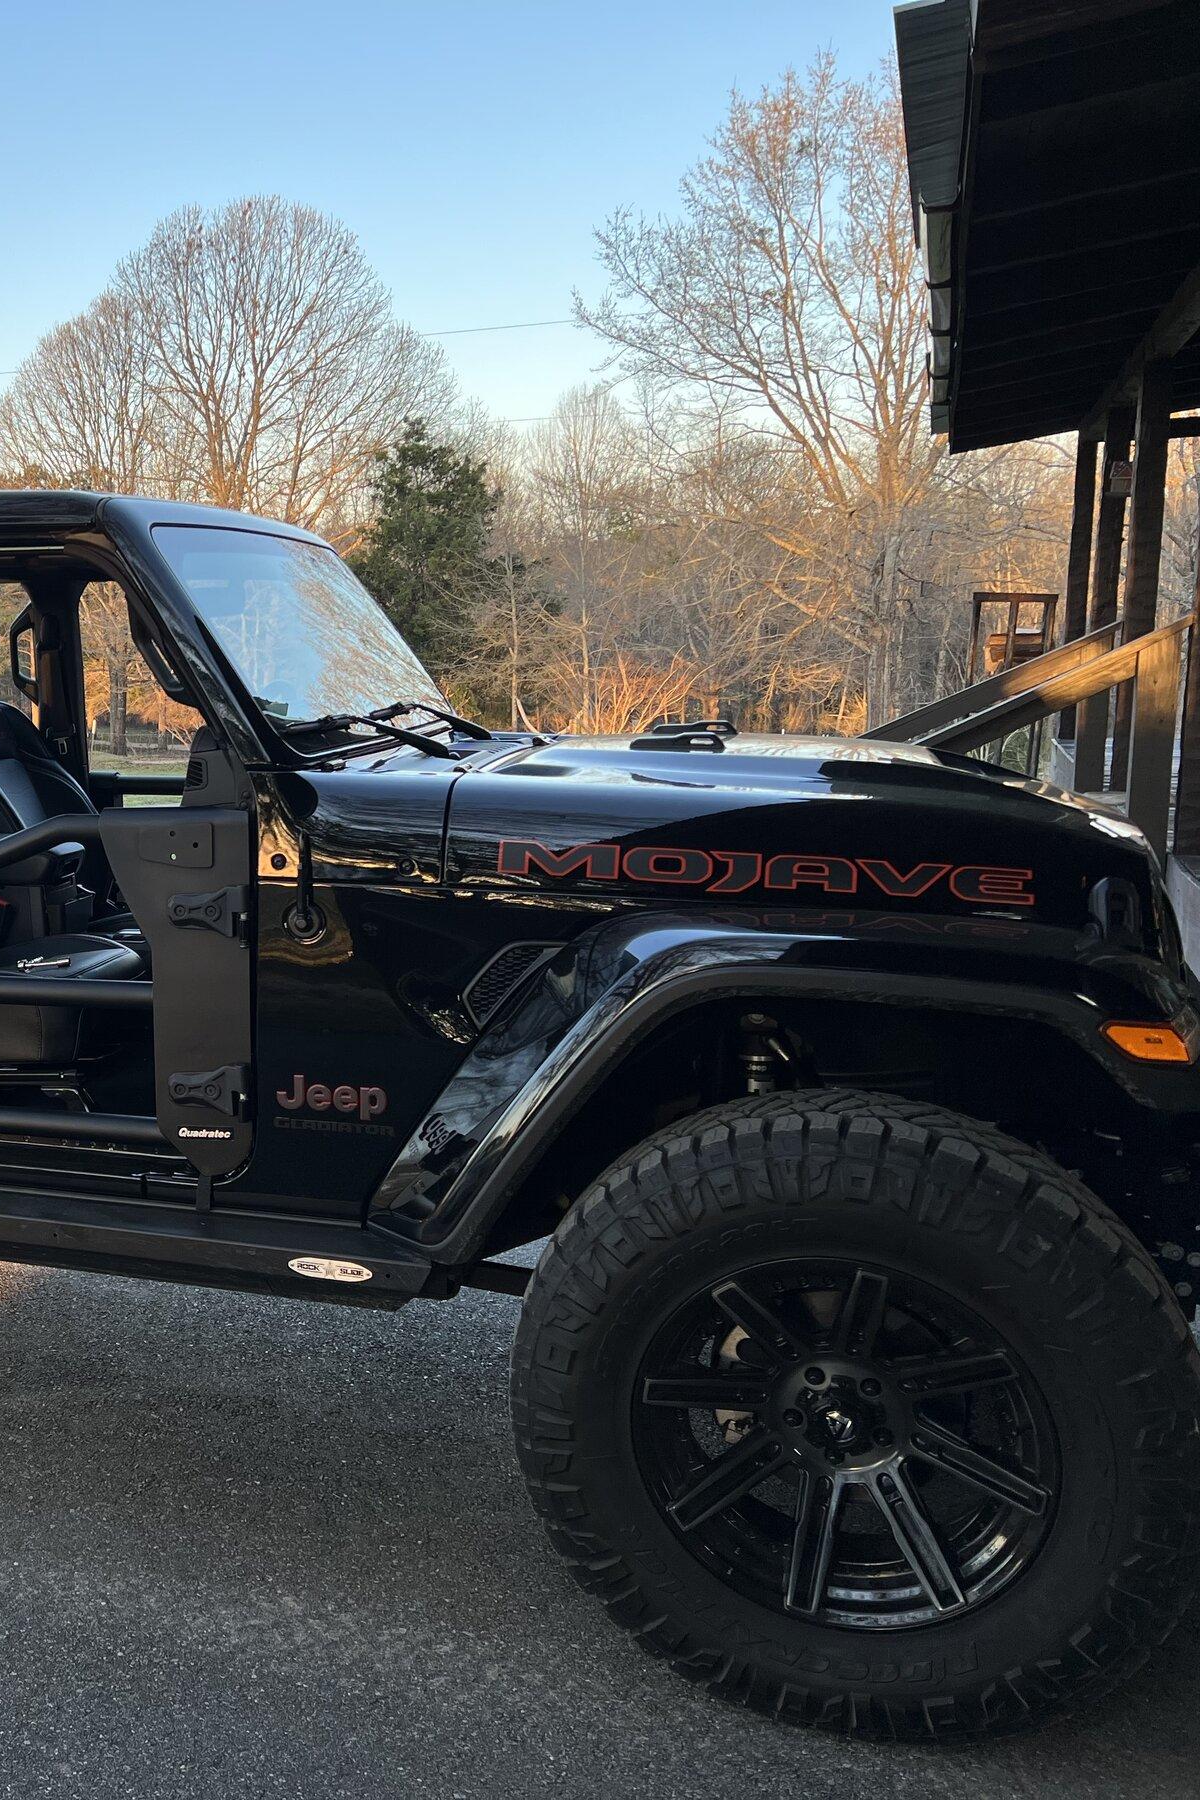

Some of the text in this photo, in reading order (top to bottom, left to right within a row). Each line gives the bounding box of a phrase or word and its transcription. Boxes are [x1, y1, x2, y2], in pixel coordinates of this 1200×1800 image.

[497, 839, 1035, 906] MOJAVE
[276, 1074, 388, 1121] Jeep
[178, 1127, 231, 1139] Quadratec
[273, 1116, 397, 1137] GLADIATOR
[297, 1263, 364, 1277] ROCK SLIDE
